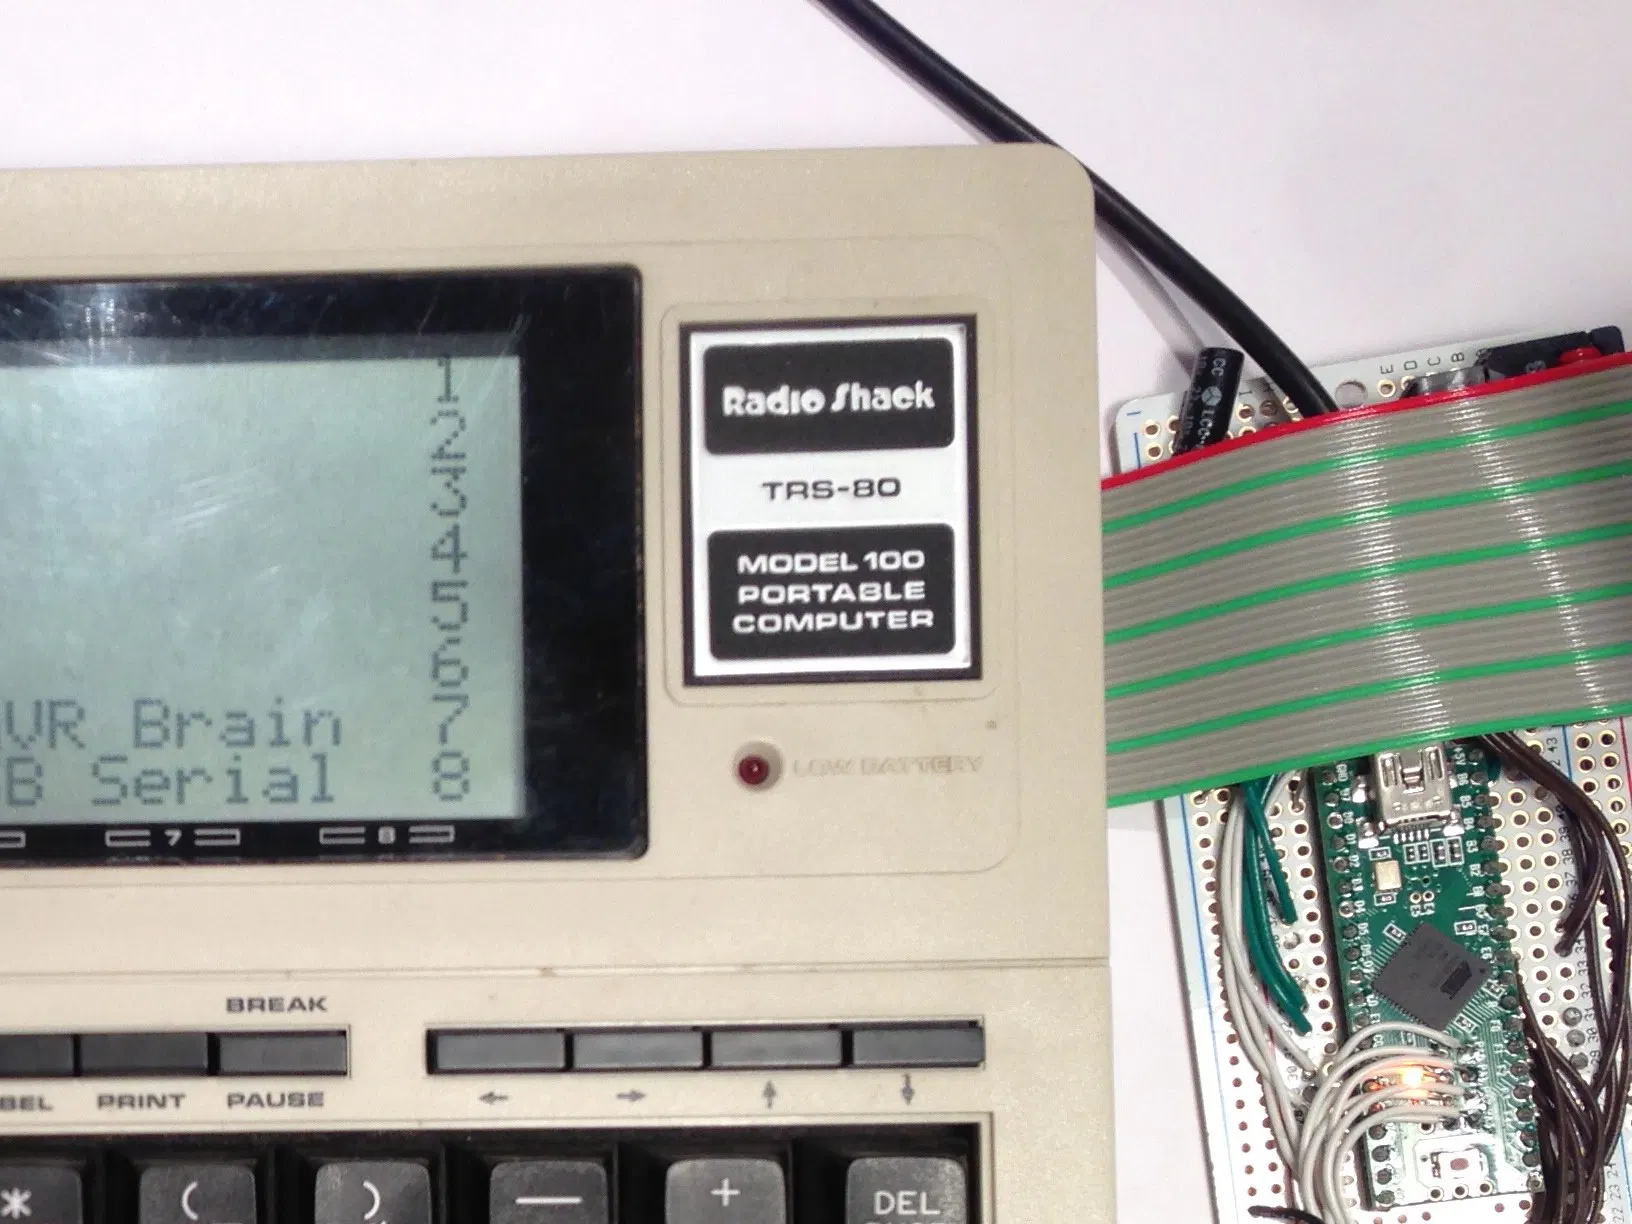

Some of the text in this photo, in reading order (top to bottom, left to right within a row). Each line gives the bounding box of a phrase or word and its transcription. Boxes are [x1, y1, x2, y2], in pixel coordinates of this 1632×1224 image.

[437, 354, 459, 402] 1
[722, 381, 935, 416] Radio Shack
[430, 408, 466, 461] 2
[431, 466, 467, 517] 3
[761, 477, 902, 501] TRS-80
[431, 524, 467, 573] 4
[737, 551, 925, 574] MODEL 100
[431, 580, 468, 631] 5
[738, 580, 926, 605] PORTABLE
[732, 609, 934, 634] COMPUTER
[431, 637, 468, 688] 6
[132, 699, 341, 749] Brain
[431, 694, 468, 745] 7
[92, 753, 335, 805] Serial
[431, 751, 469, 802] 8
[225, 996, 327, 1014] BREAK
[96, 1093, 186, 1110] PRINT
[226, 1091, 325, 1109] PAUSE
[875, 1189, 941, 1216] DEL
